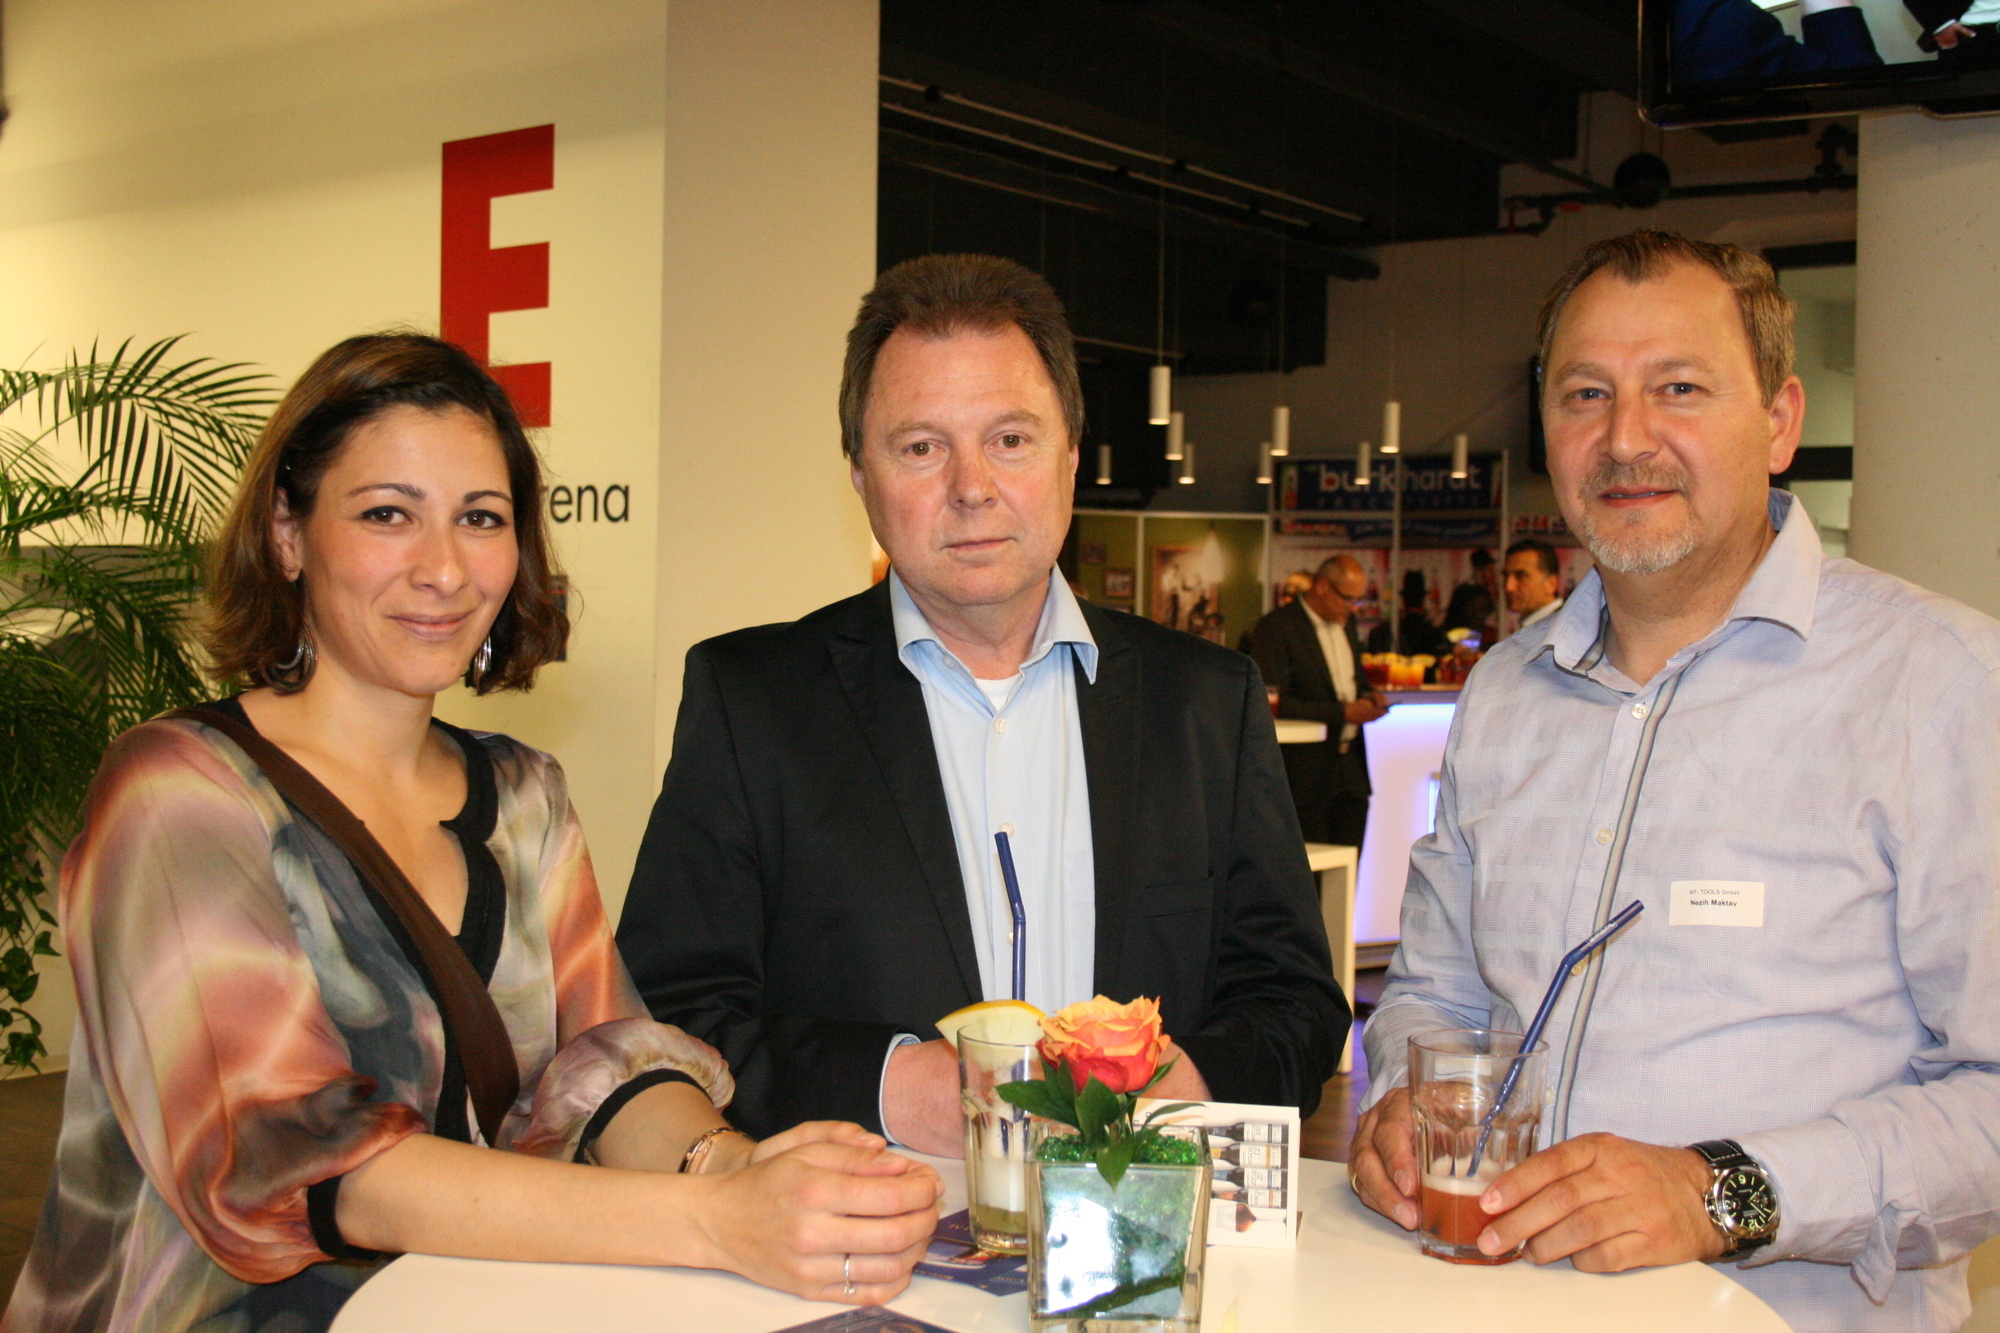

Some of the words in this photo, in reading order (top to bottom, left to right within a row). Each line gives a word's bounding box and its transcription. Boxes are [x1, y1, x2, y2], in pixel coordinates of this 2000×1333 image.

[440, 123, 555, 428] E
[540, 484, 629, 523] ena
[1711, 899, 1738, 907] Maktav
